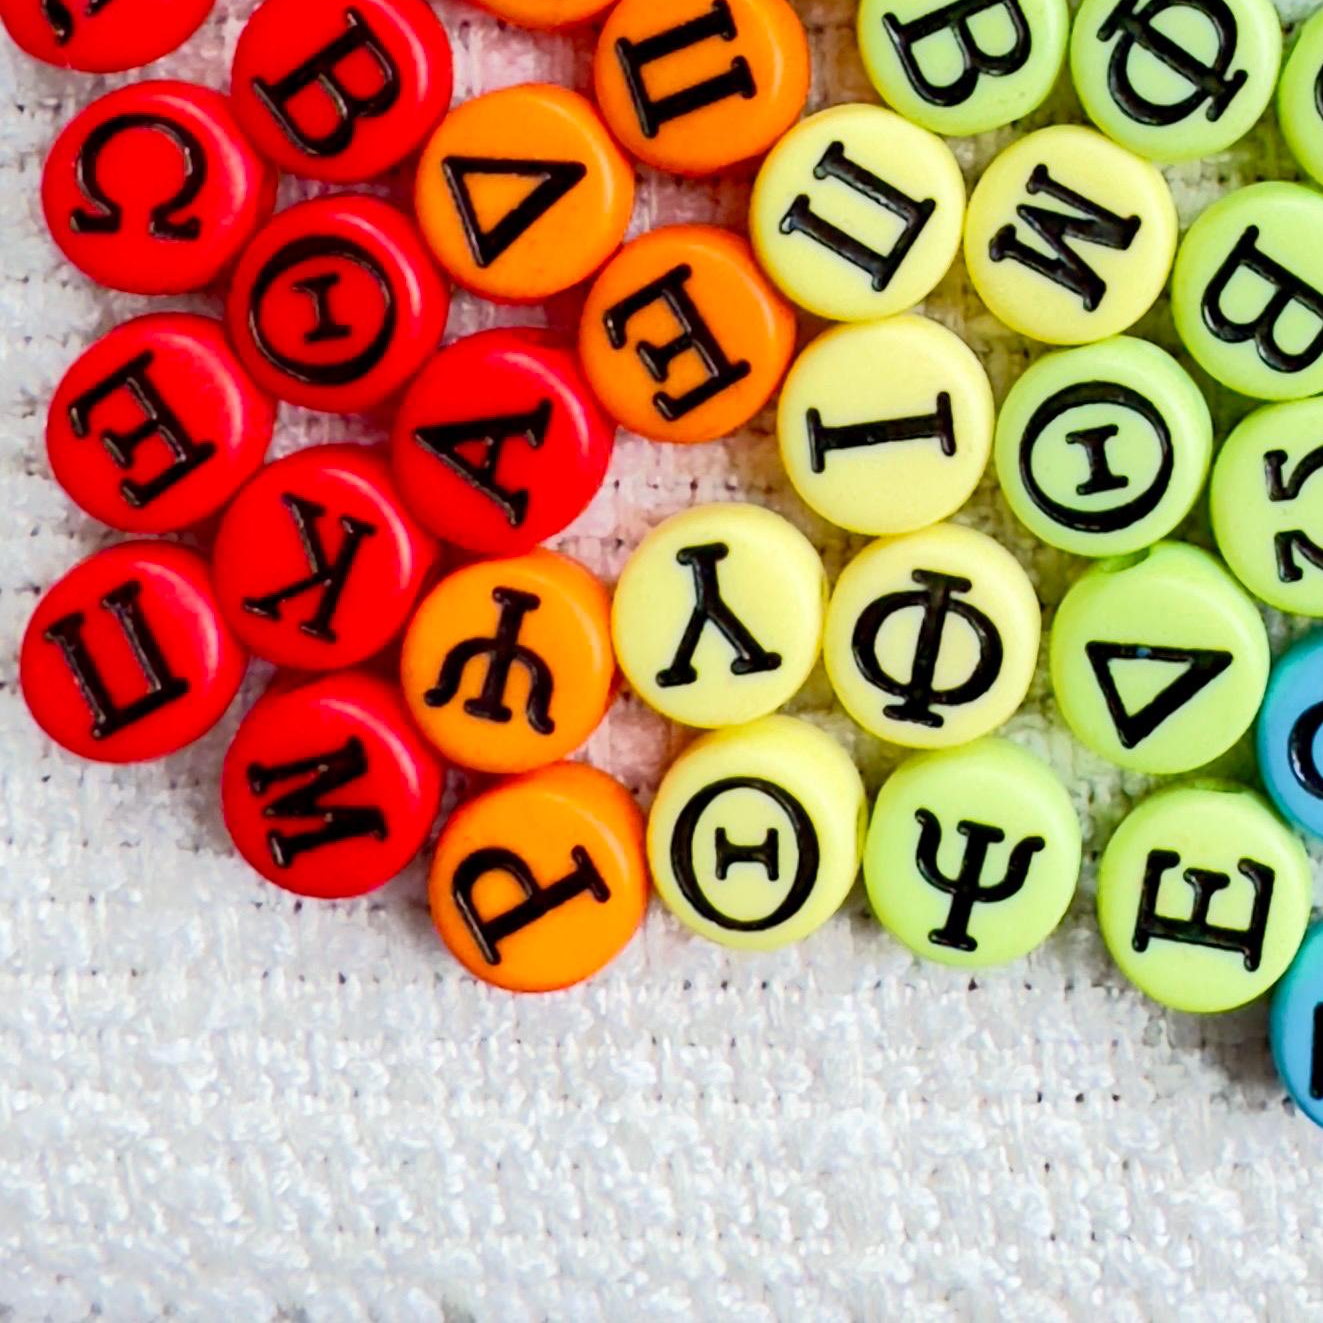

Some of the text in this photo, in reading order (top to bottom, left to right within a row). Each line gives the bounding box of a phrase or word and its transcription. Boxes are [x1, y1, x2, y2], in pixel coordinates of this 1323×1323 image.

[71, 113, 207, 240] Ω
[442, 156, 586, 268] Δ
[778, 140, 937, 293] Π
[249, 235, 397, 387] Θ
[1018, 380, 1175, 534] Θ
[45, 580, 189, 741] Π
[425, 588, 554, 735] Ψ
[851, 568, 1004, 729] Φ
[1084, 640, 1234, 750] Δ
[669, 776, 820, 932] Θ
[914, 808, 1046, 953] Ψ
